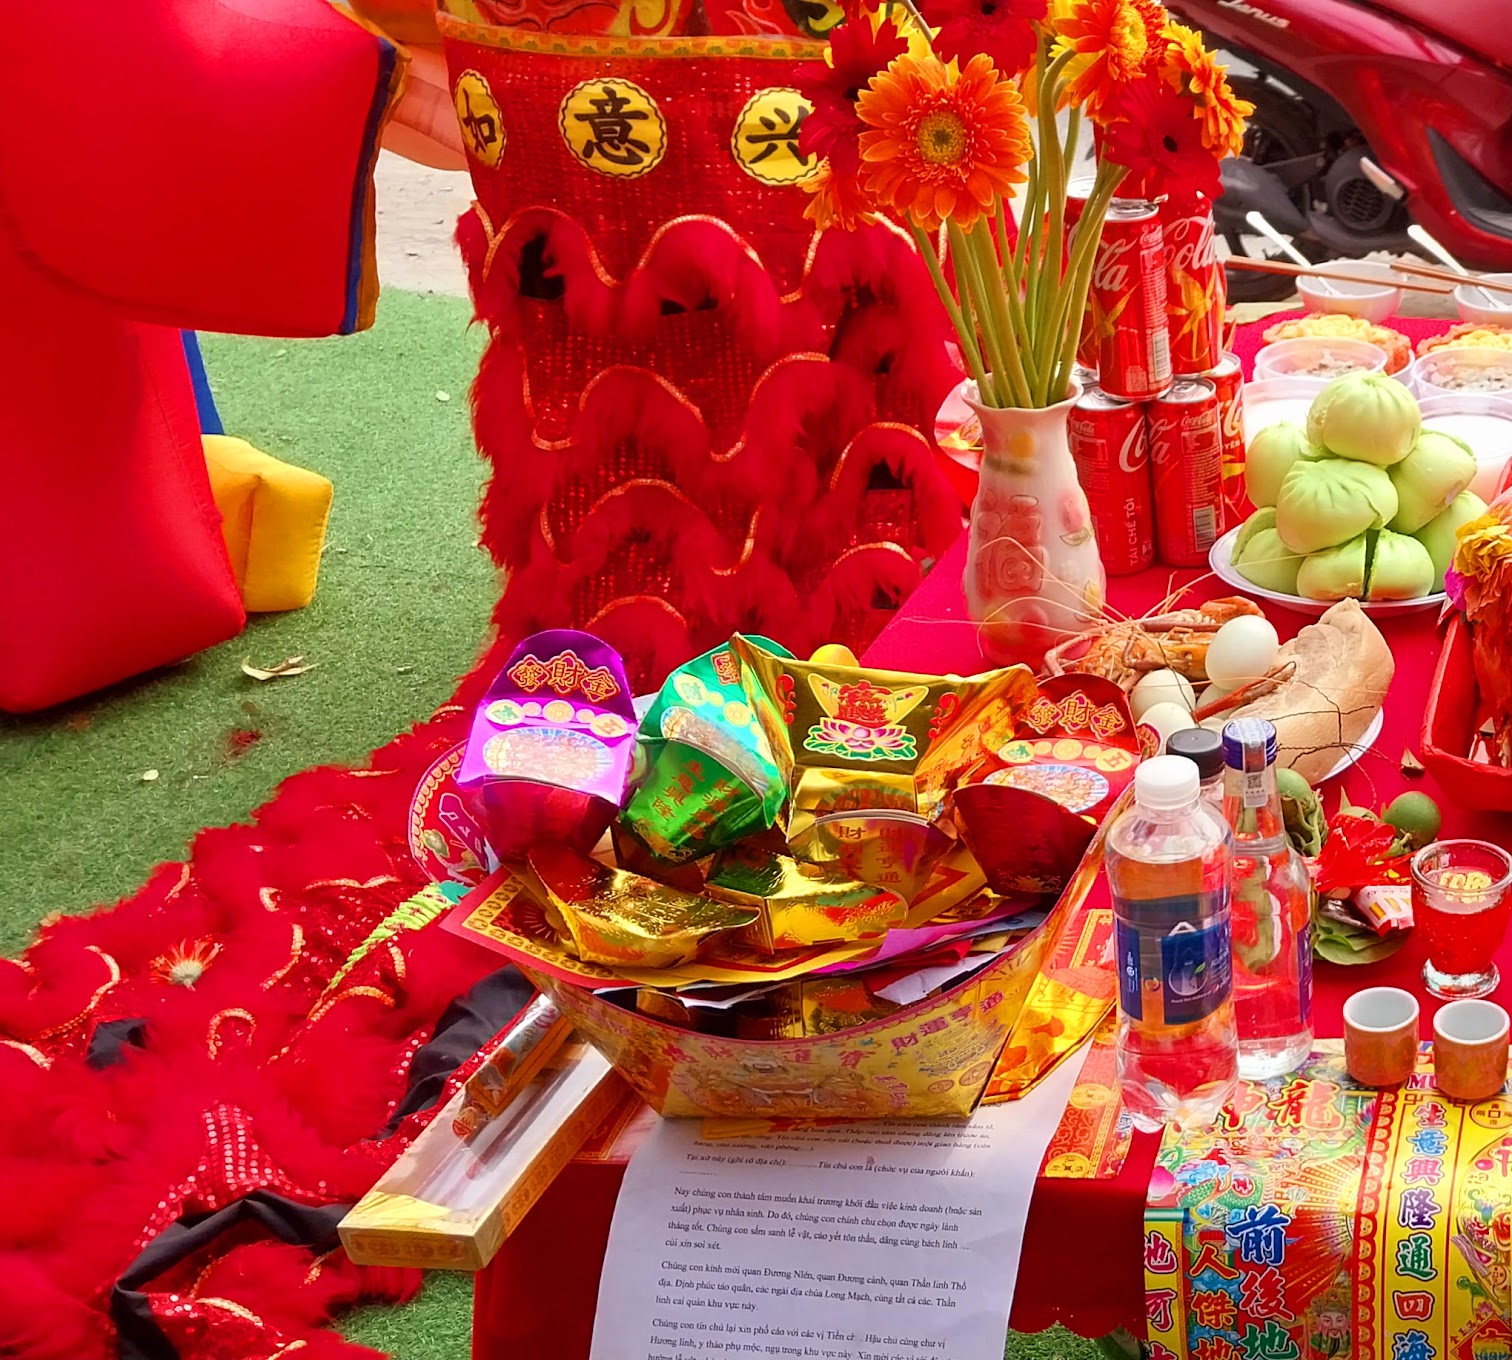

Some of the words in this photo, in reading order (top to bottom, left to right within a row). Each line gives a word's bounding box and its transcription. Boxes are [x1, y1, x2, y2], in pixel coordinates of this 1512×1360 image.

[461, 88, 496, 153] 如
[574, 86, 652, 166] 意
[745, 105, 814, 167] 兴
[1392, 1103, 1449, 1360] 生意興隆通四海
